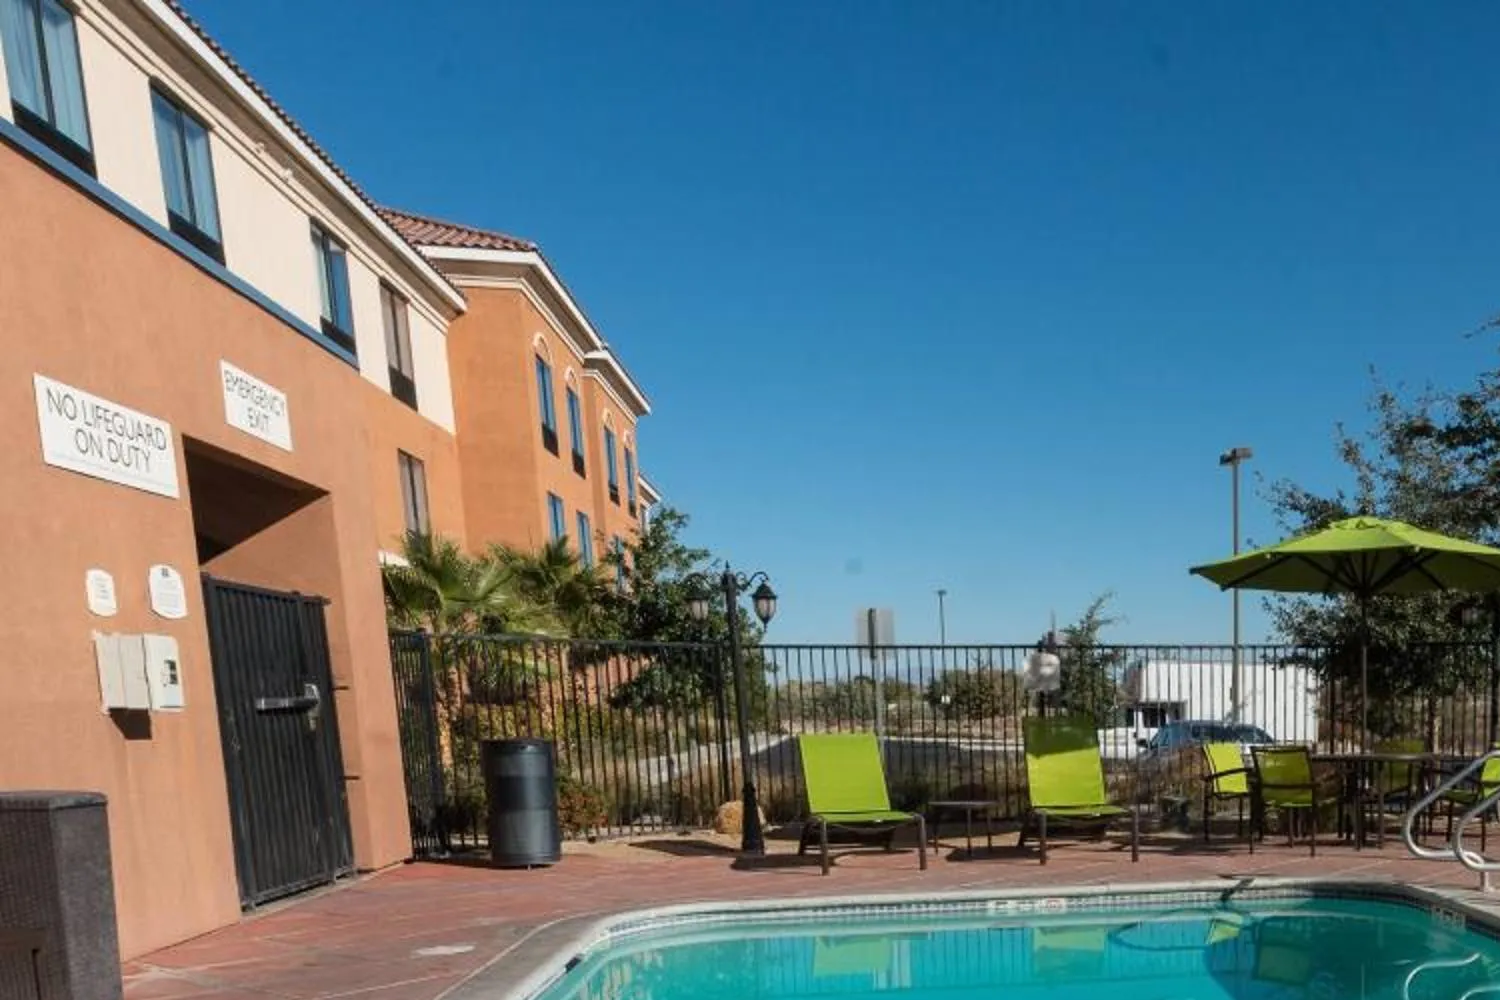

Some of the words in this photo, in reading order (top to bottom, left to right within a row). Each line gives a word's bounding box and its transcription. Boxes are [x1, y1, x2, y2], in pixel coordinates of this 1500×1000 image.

[224, 369, 285, 417] EMERGENCY
[46, 387, 77, 421] NO
[81, 400, 167, 451] LIFEGUARD
[247, 406, 270, 433] EXIT
[74, 428, 103, 460] ON
[107, 438, 151, 473] DUTY
